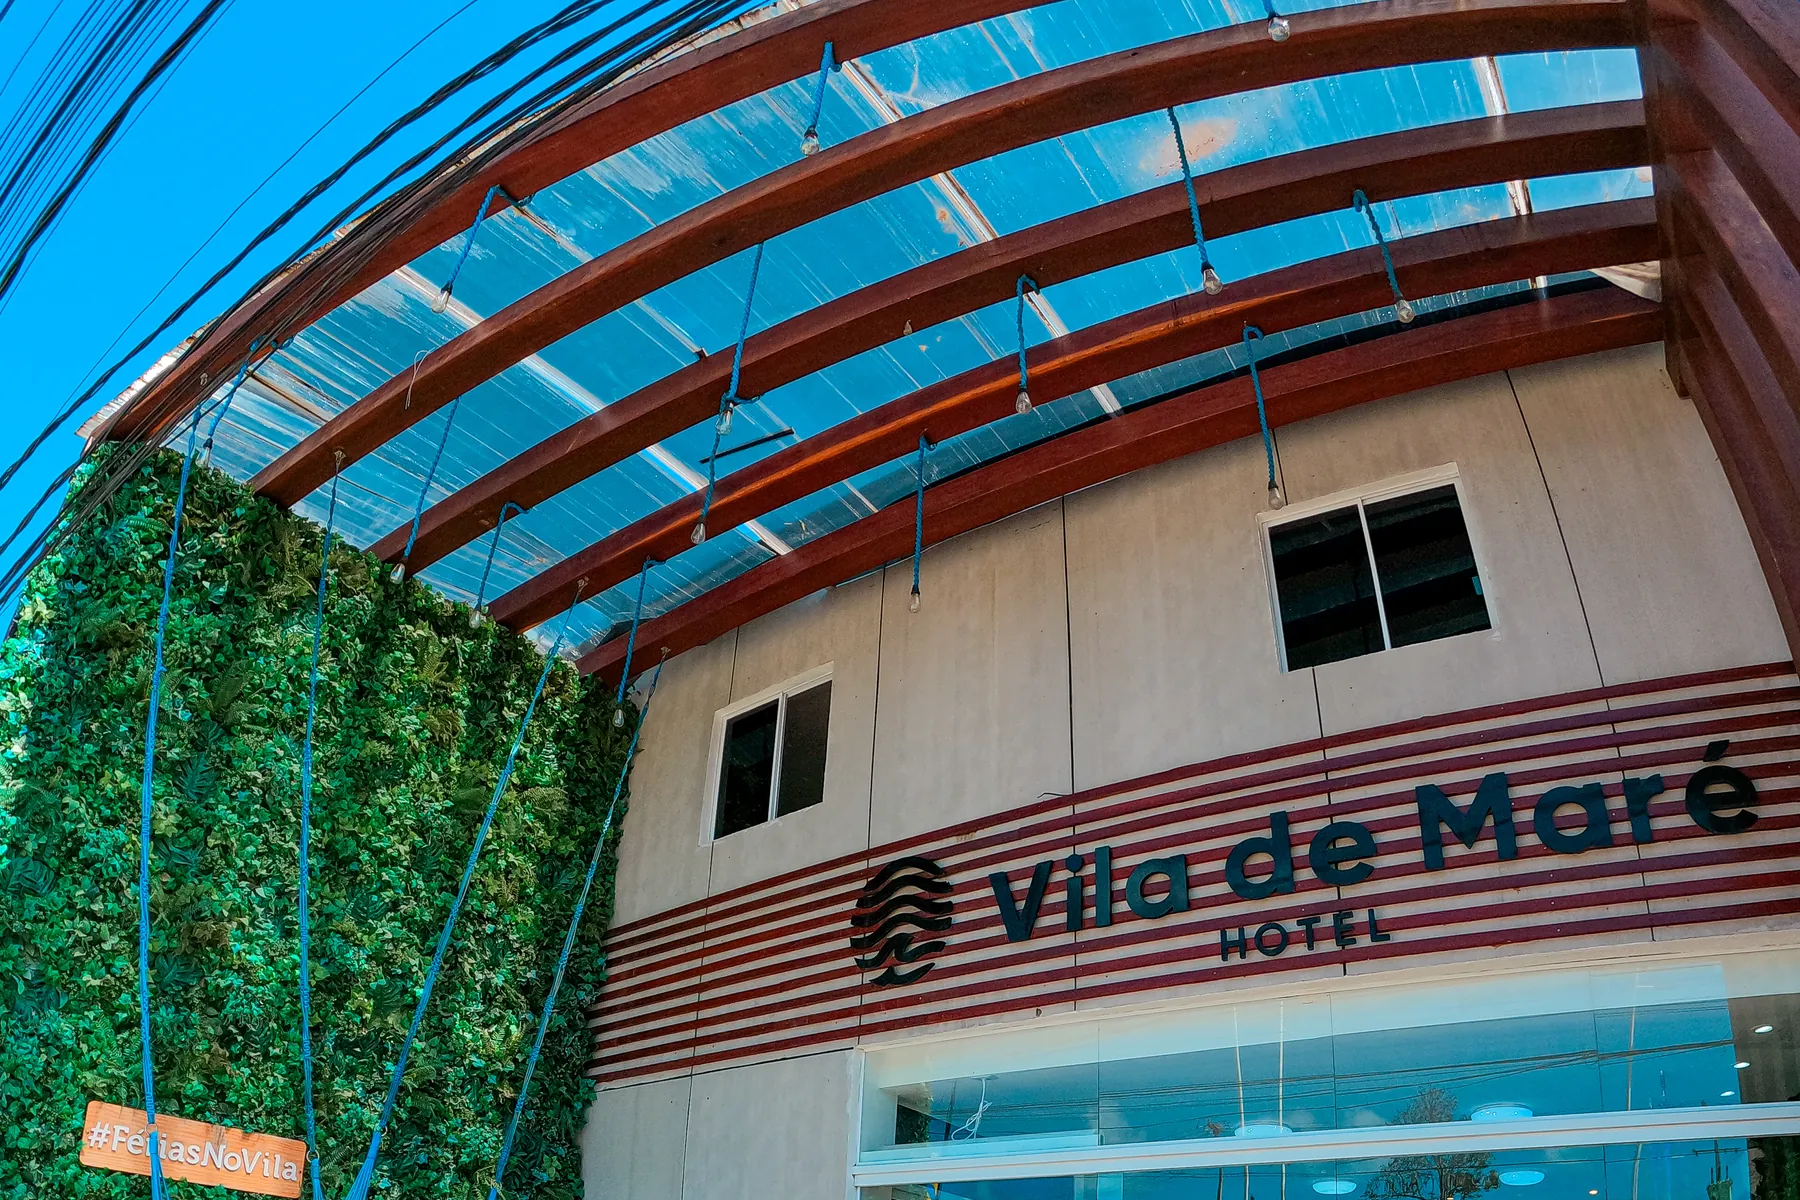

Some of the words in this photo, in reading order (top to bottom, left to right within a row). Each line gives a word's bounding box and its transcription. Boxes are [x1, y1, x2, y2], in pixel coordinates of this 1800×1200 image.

[989, 845, 1190, 942] Vila
[1224, 811, 1377, 900] de
[1415, 739, 1759, 870] Maré
[1220, 908, 1391, 962] HOTEL
[88, 1121, 298, 1181] #FéiasNoVila
